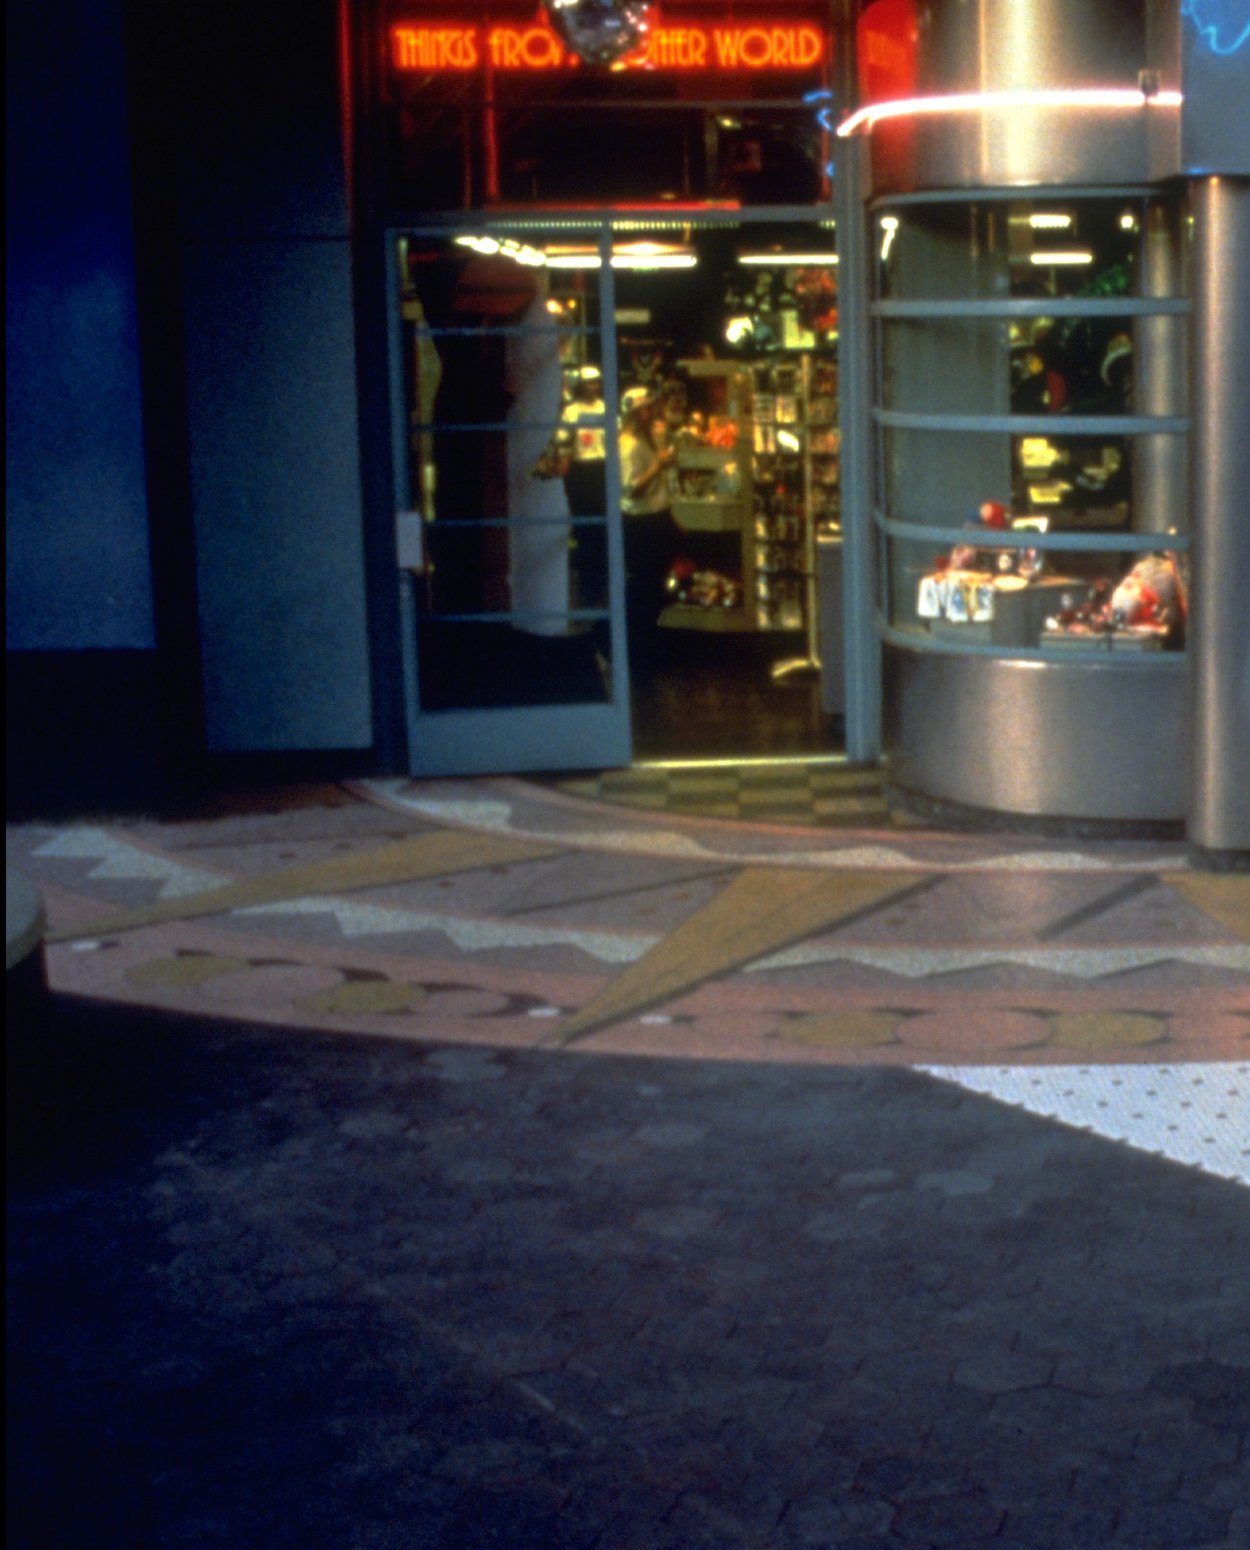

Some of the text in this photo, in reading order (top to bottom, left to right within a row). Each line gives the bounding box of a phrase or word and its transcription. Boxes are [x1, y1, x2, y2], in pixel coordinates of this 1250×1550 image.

[394, 28, 478, 68] THINGS
[649, 29, 706, 67] THER
[712, 28, 822, 67] WORLD
